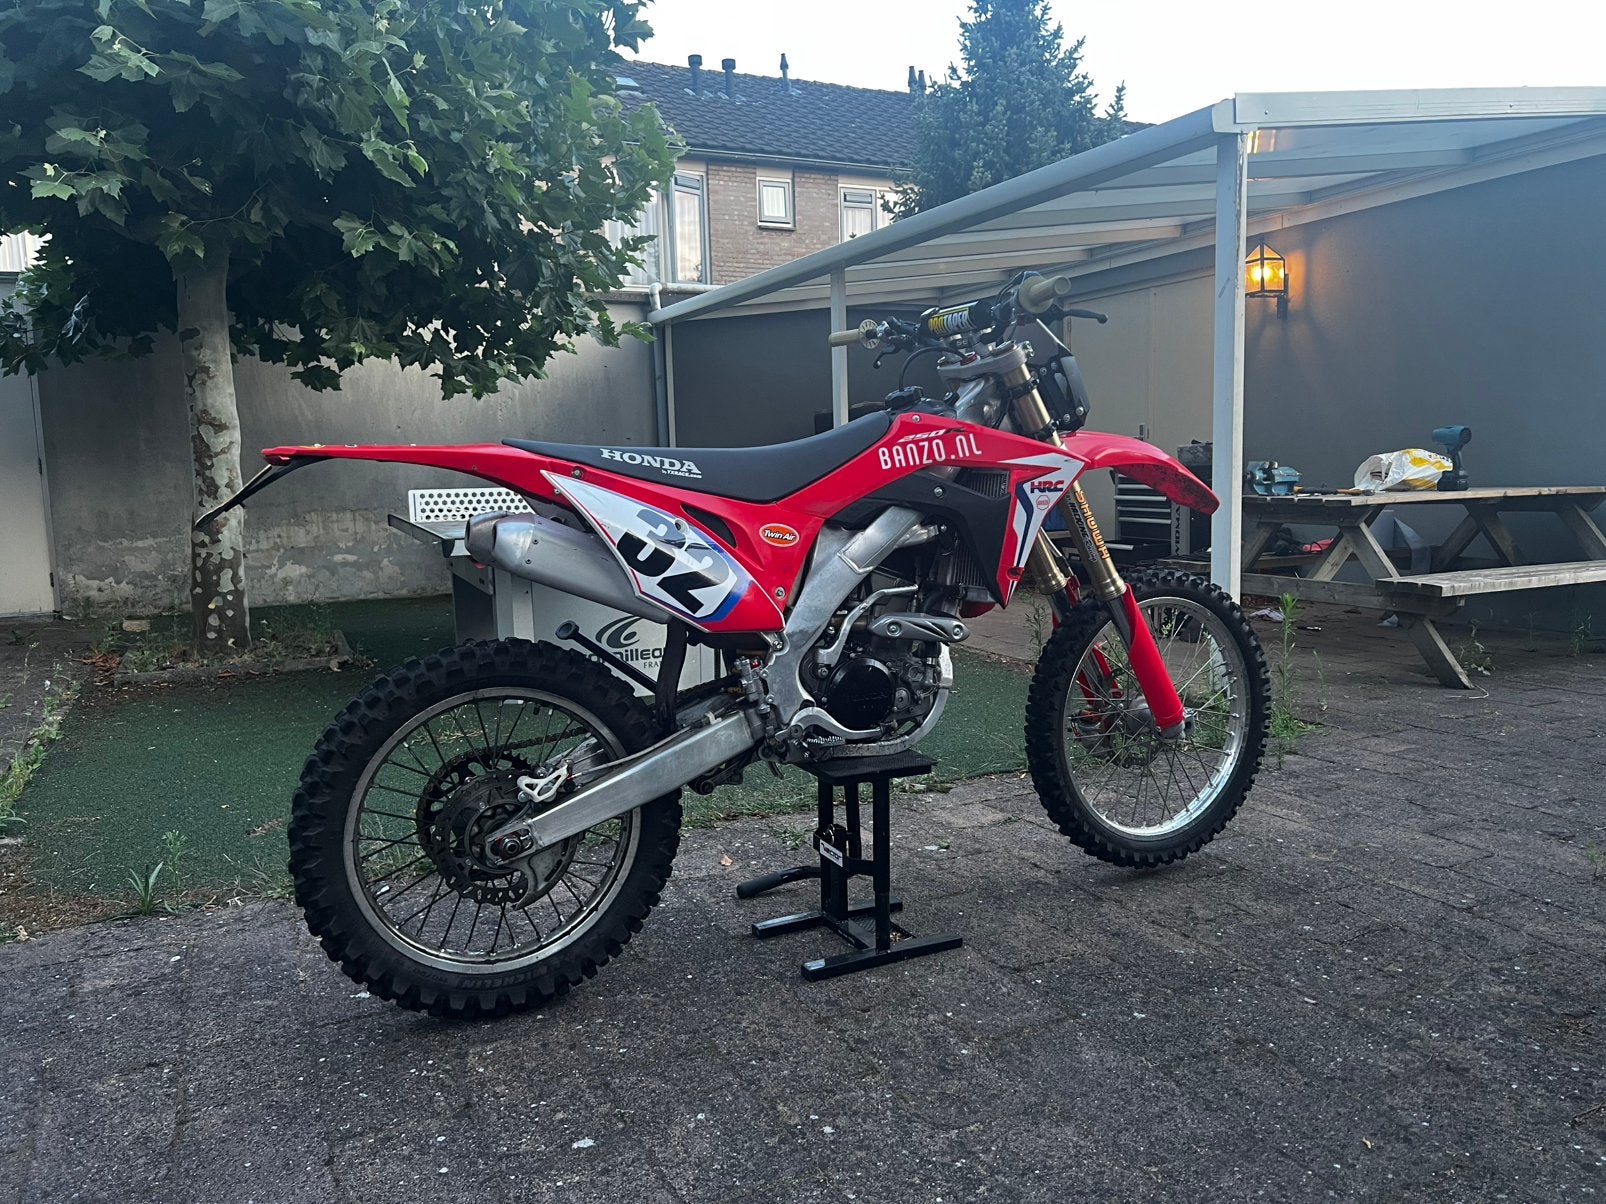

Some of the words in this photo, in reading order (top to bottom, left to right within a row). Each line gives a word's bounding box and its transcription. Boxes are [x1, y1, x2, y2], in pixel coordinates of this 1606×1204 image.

[928, 310, 971, 333] PROTAPER
[600, 448, 702, 474] HONDA
[879, 433, 982, 470] BANZO.NL
[1030, 480, 1065, 493] HRC
[764, 529, 783, 539] Twin
[783, 533, 796, 541] Air
[1075, 490, 1110, 559] SHOWA
[617, 509, 730, 614] 32
[643, 661, 660, 669] FRA
